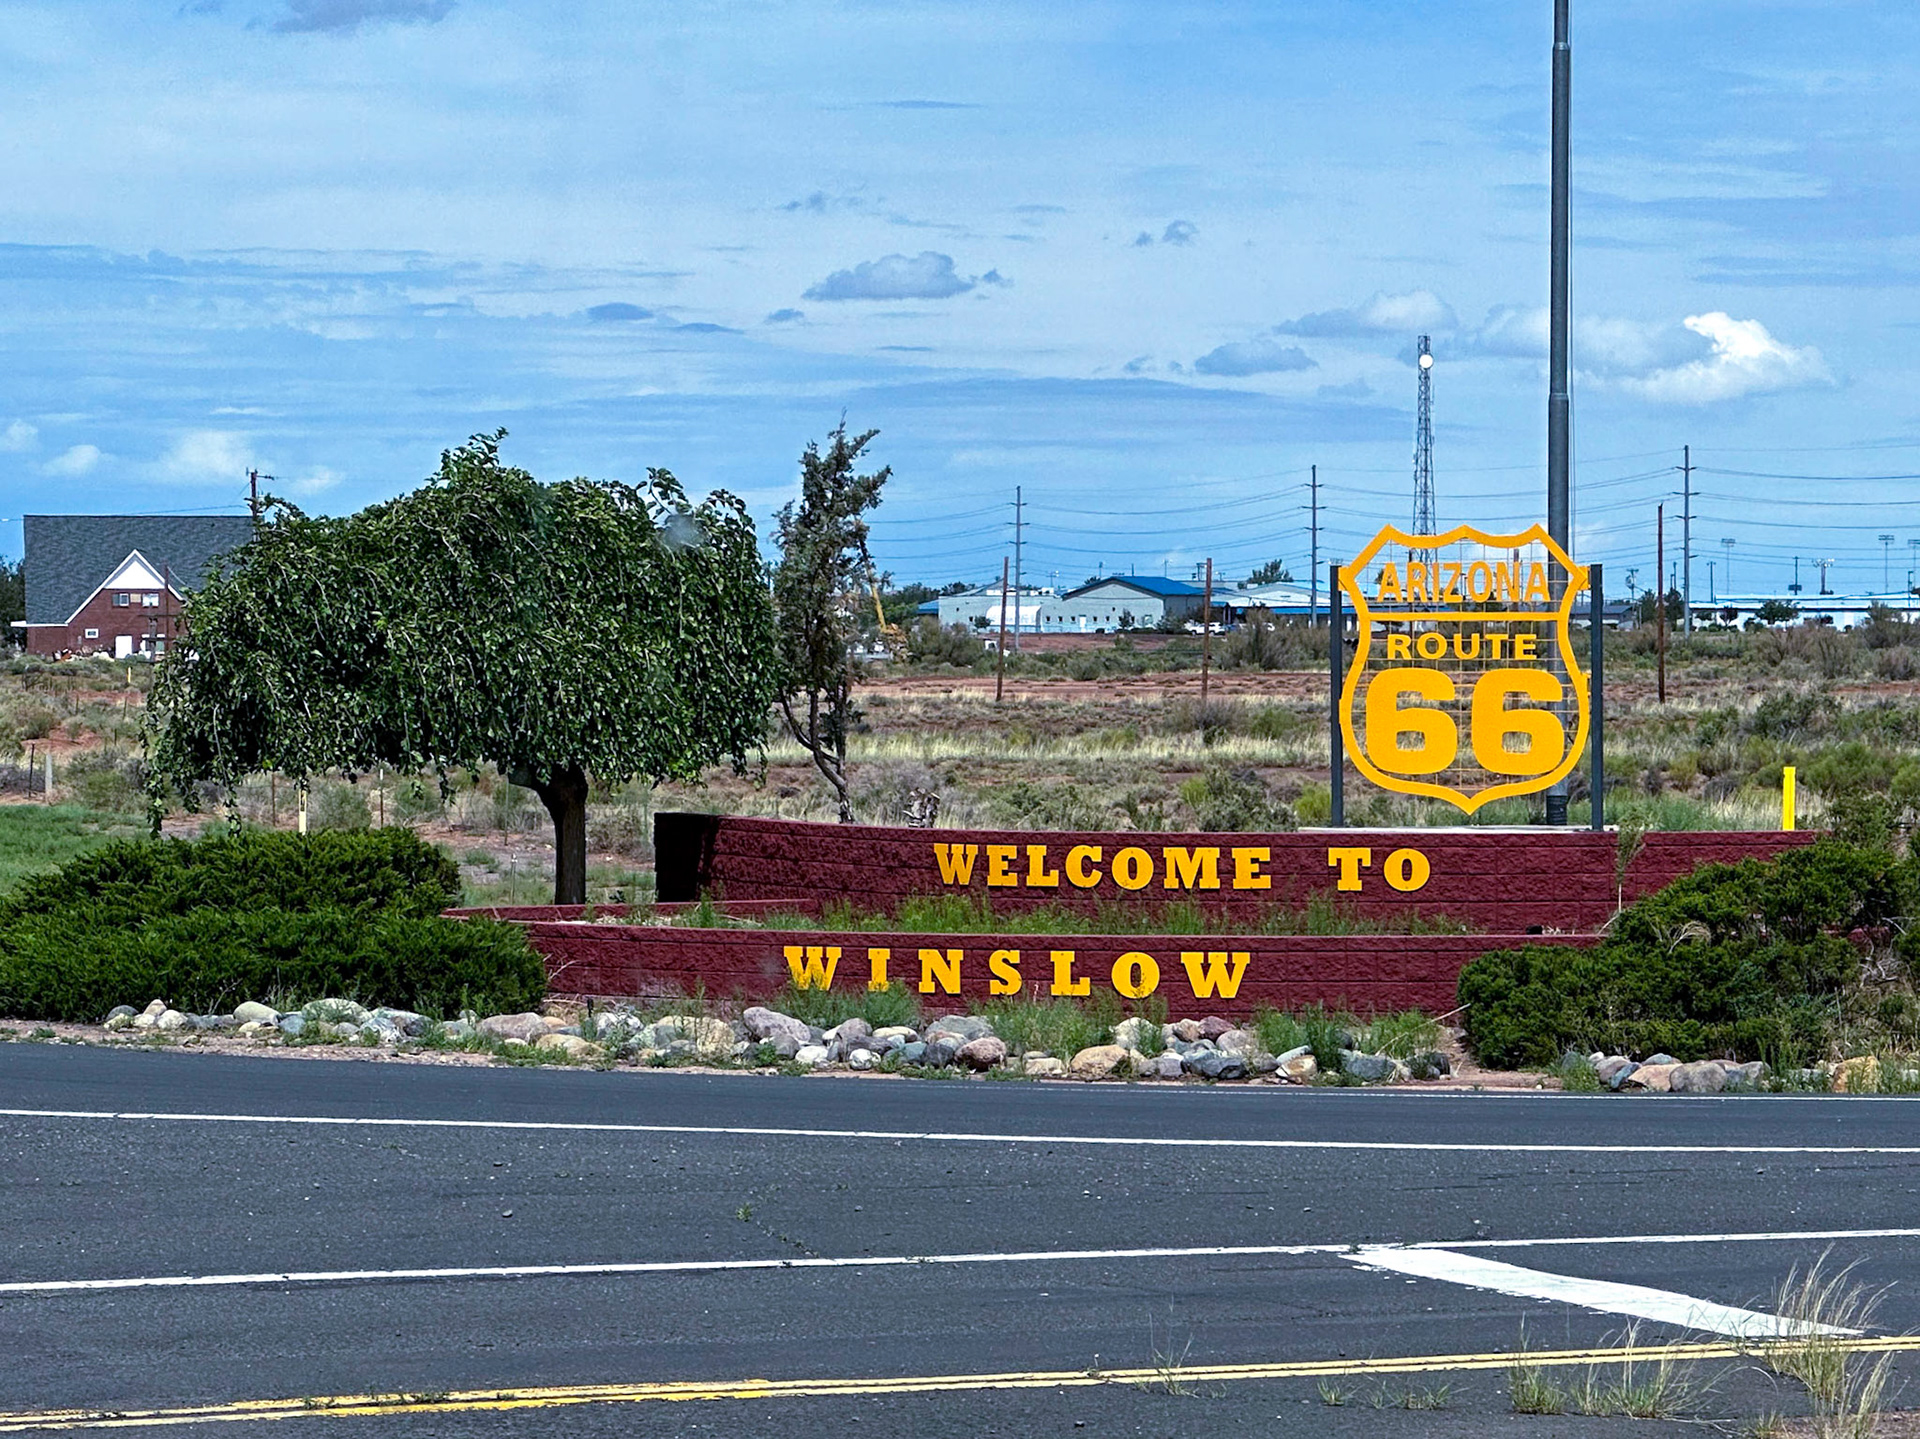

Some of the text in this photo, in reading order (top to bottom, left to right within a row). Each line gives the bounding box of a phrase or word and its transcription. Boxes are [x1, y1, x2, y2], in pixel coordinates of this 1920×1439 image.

[1377, 561, 1551, 603] ARIZONA
[1387, 632, 1537, 660] ROUTE
[1366, 667, 1565, 776] 66
[934, 843, 1430, 892] WELCOME TO
[783, 946, 1251, 999] WINSLOW
